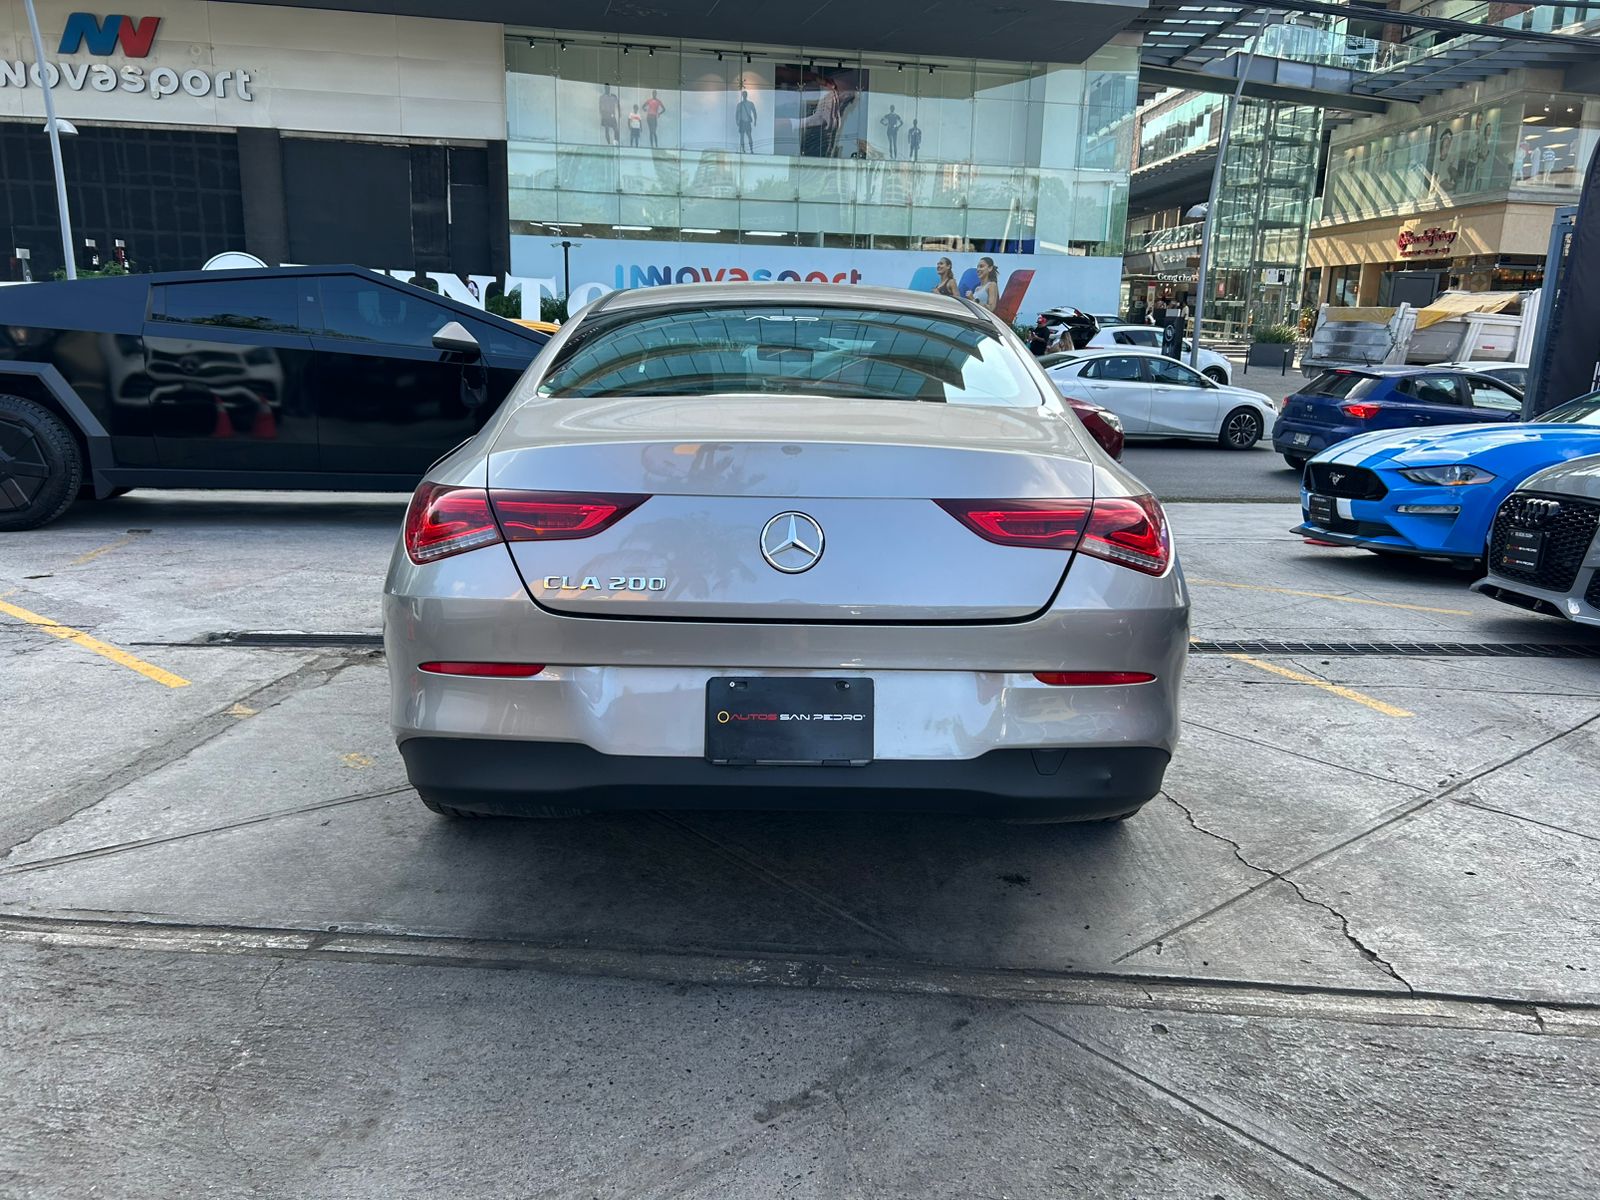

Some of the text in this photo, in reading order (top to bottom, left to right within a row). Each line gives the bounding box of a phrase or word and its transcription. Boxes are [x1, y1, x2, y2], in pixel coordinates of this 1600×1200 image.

[1157, 272, 1178, 283] Gong
[543, 575, 667, 591] CLA 200
[730, 713, 778, 721] AUTOS
[779, 713, 811, 721] SAN
